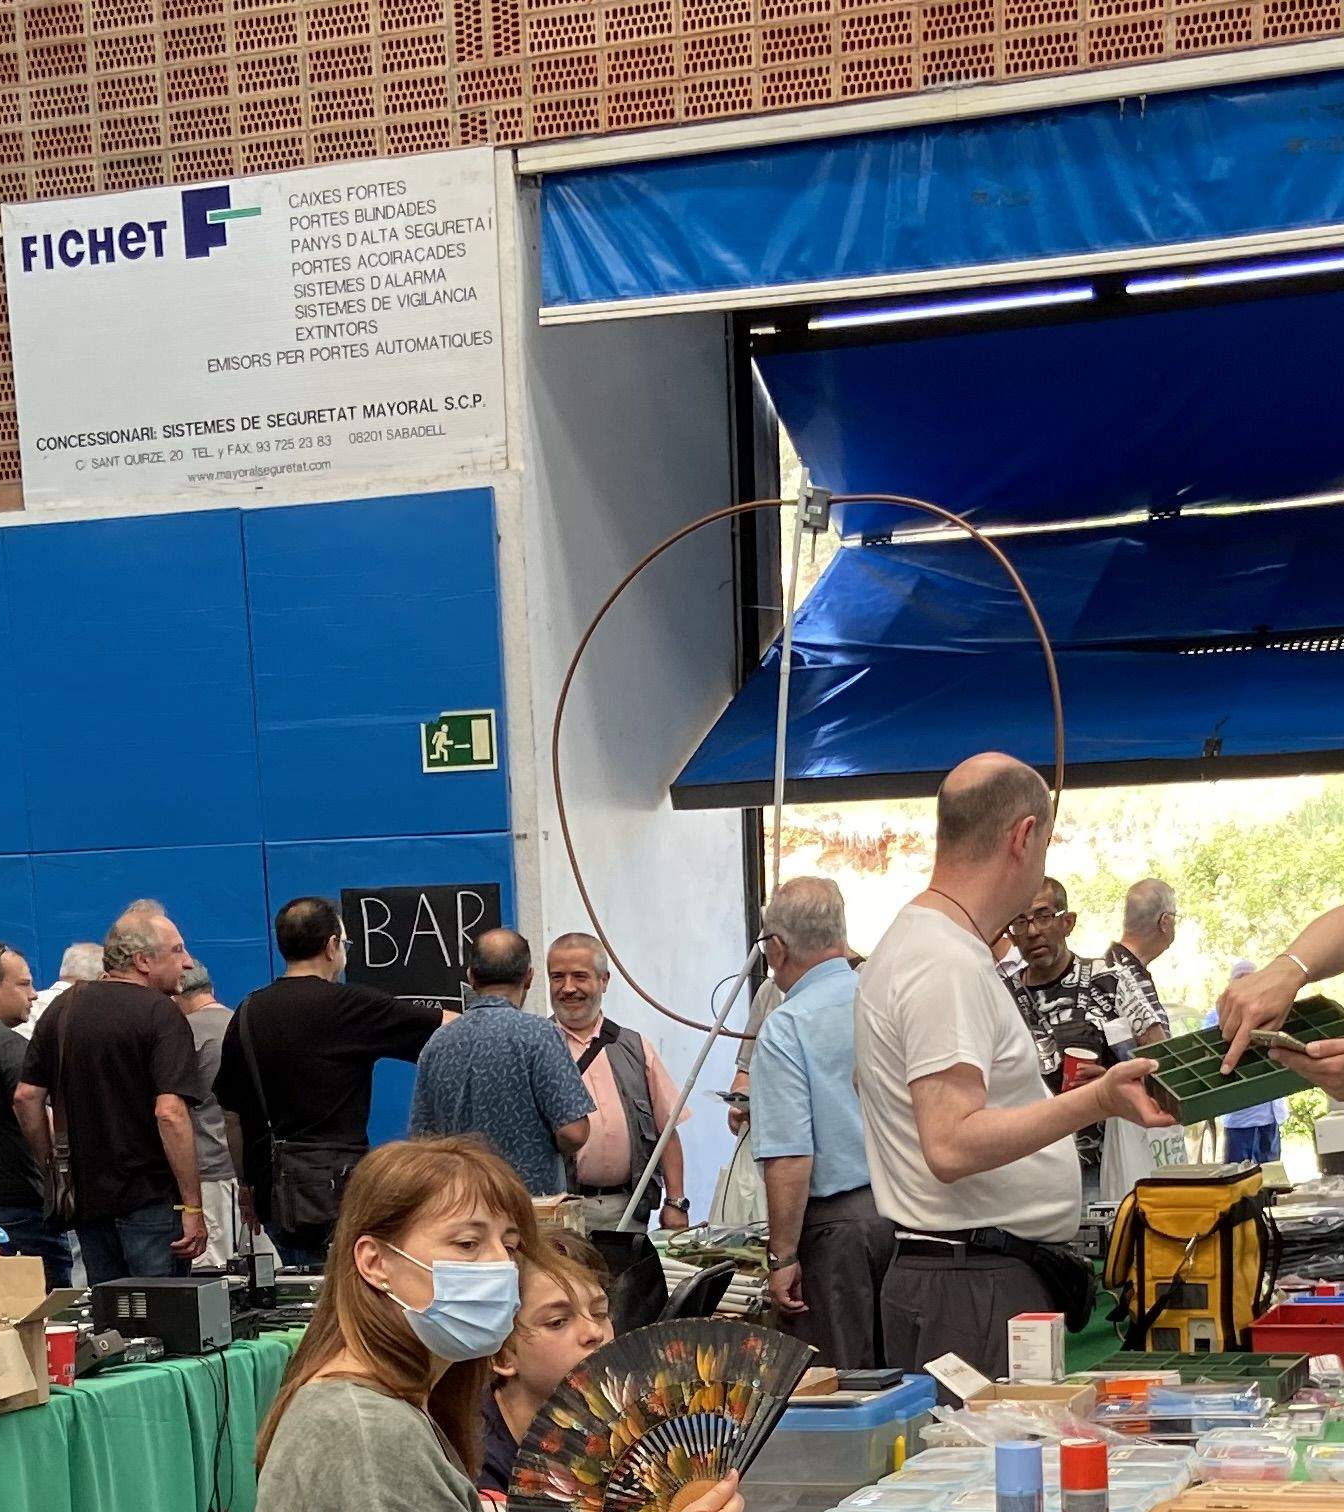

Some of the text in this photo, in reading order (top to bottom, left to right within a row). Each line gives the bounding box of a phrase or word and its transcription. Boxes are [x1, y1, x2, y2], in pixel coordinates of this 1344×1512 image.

[288, 180, 407, 209] CAIXES FORTES
[289, 199, 437, 231] PORTES BLINDADES
[291, 231, 341, 254] PANYS
[292, 256, 351, 277] PORTES
[293, 276, 365, 299] SISTEMES
[294, 296, 367, 319] SISTEMES
[371, 295, 391, 312] DE
[295, 319, 378, 342] EXTINTORS
[207, 330, 494, 374] EMISORS PER PORTES AUTOMATIQUES
[36, 393, 487, 452] CONCESSIONARI: SISTEMES DE SEGURETAT MAYORAL S.C.P.
[169, 449, 184, 462] 20
[255, 439, 272, 453] 93
[274, 438, 295, 452] 725
[298, 436, 314, 450] 23
[386, 424, 447, 441] SABADELL
[360, 890, 486, 969] BAR
